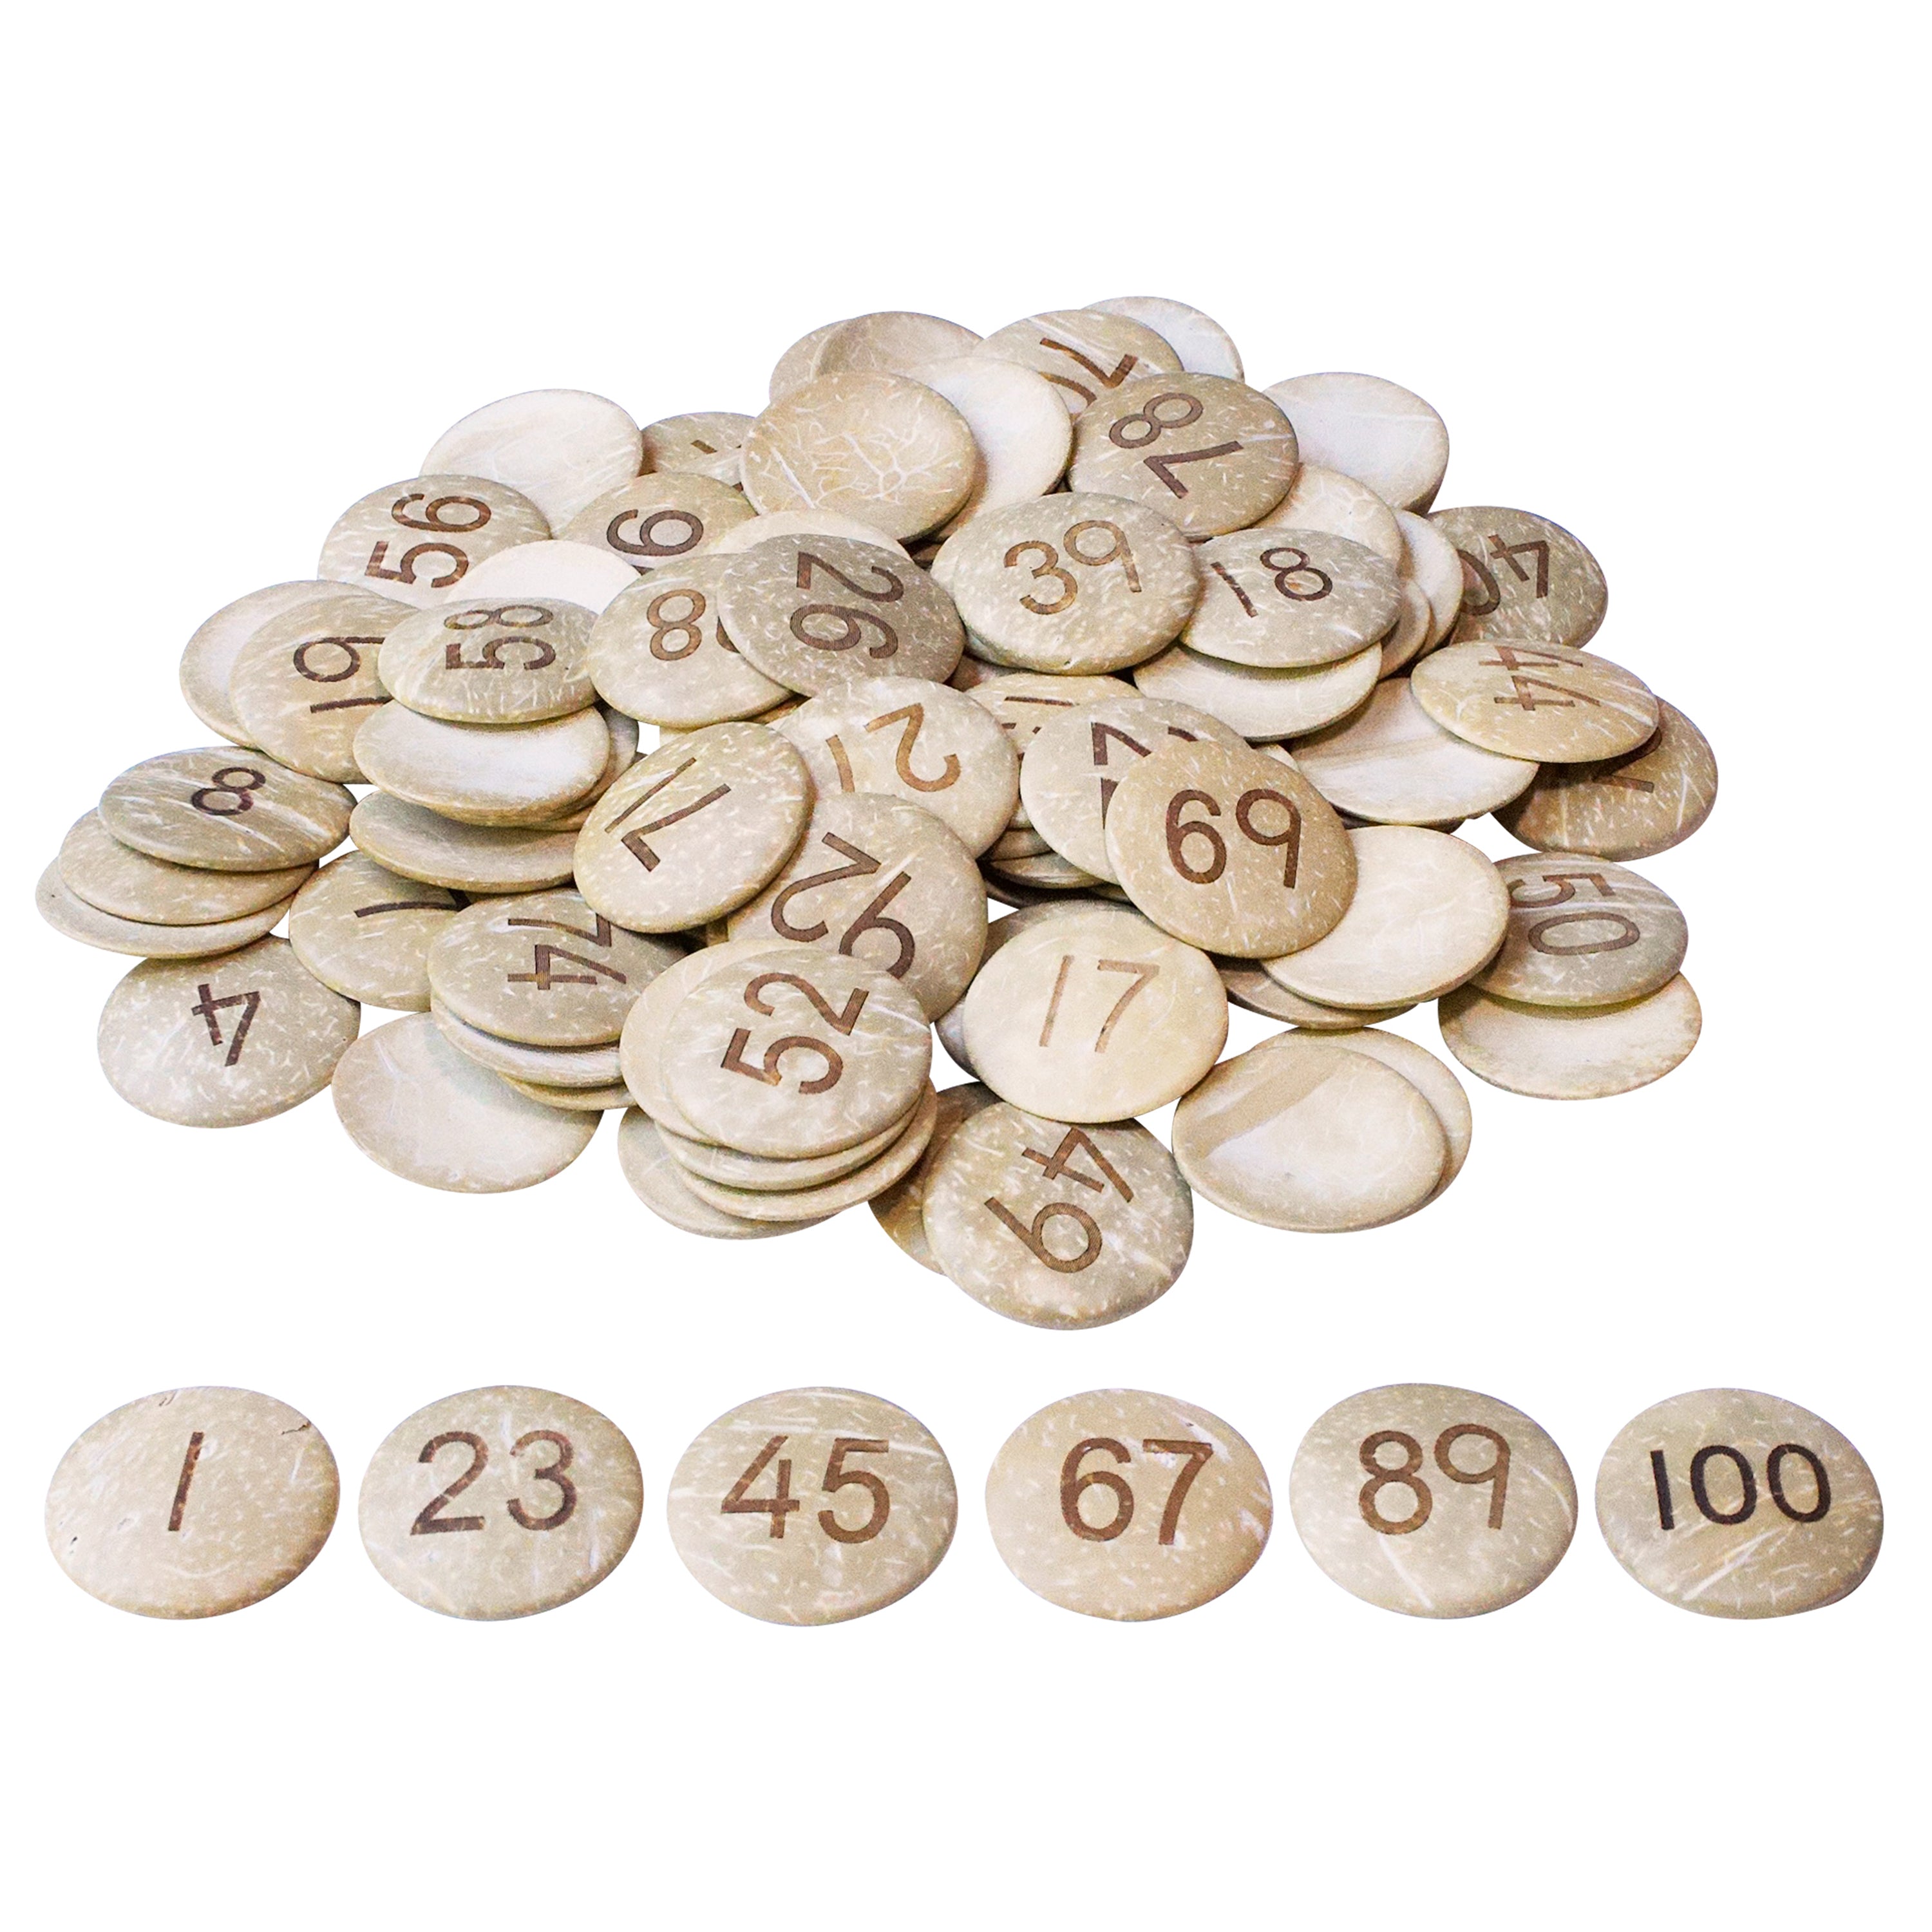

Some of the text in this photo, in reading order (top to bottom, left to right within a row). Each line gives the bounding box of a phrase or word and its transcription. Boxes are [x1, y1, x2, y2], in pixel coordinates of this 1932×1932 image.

[1109, 392, 1240, 500] 78
[365, 493, 491, 589] 56
[1003, 520, 1142, 615] 39
[1211, 547, 1333, 618] 18
[443, 604, 557, 671] 58
[789, 551, 904, 659] 26
[1479, 645, 1602, 711] 44
[191, 767, 267, 816] 8
[1166, 788, 1302, 889] 69
[507, 913, 627, 990] 74
[1510, 873, 1641, 956] 50
[191, 983, 260, 1066] 4
[720, 972, 869, 1095] 52
[1039, 954, 1160, 1053] 17
[983, 1127, 1135, 1274] 49
[167, 1431, 204, 1532] 1
[410, 1430, 579, 1536] 23
[720, 1435, 891, 1544] 45
[1059, 1437, 1213, 1546] 67
[1358, 1423, 1511, 1536] 89
[1651, 1444, 1832, 1531] 100
